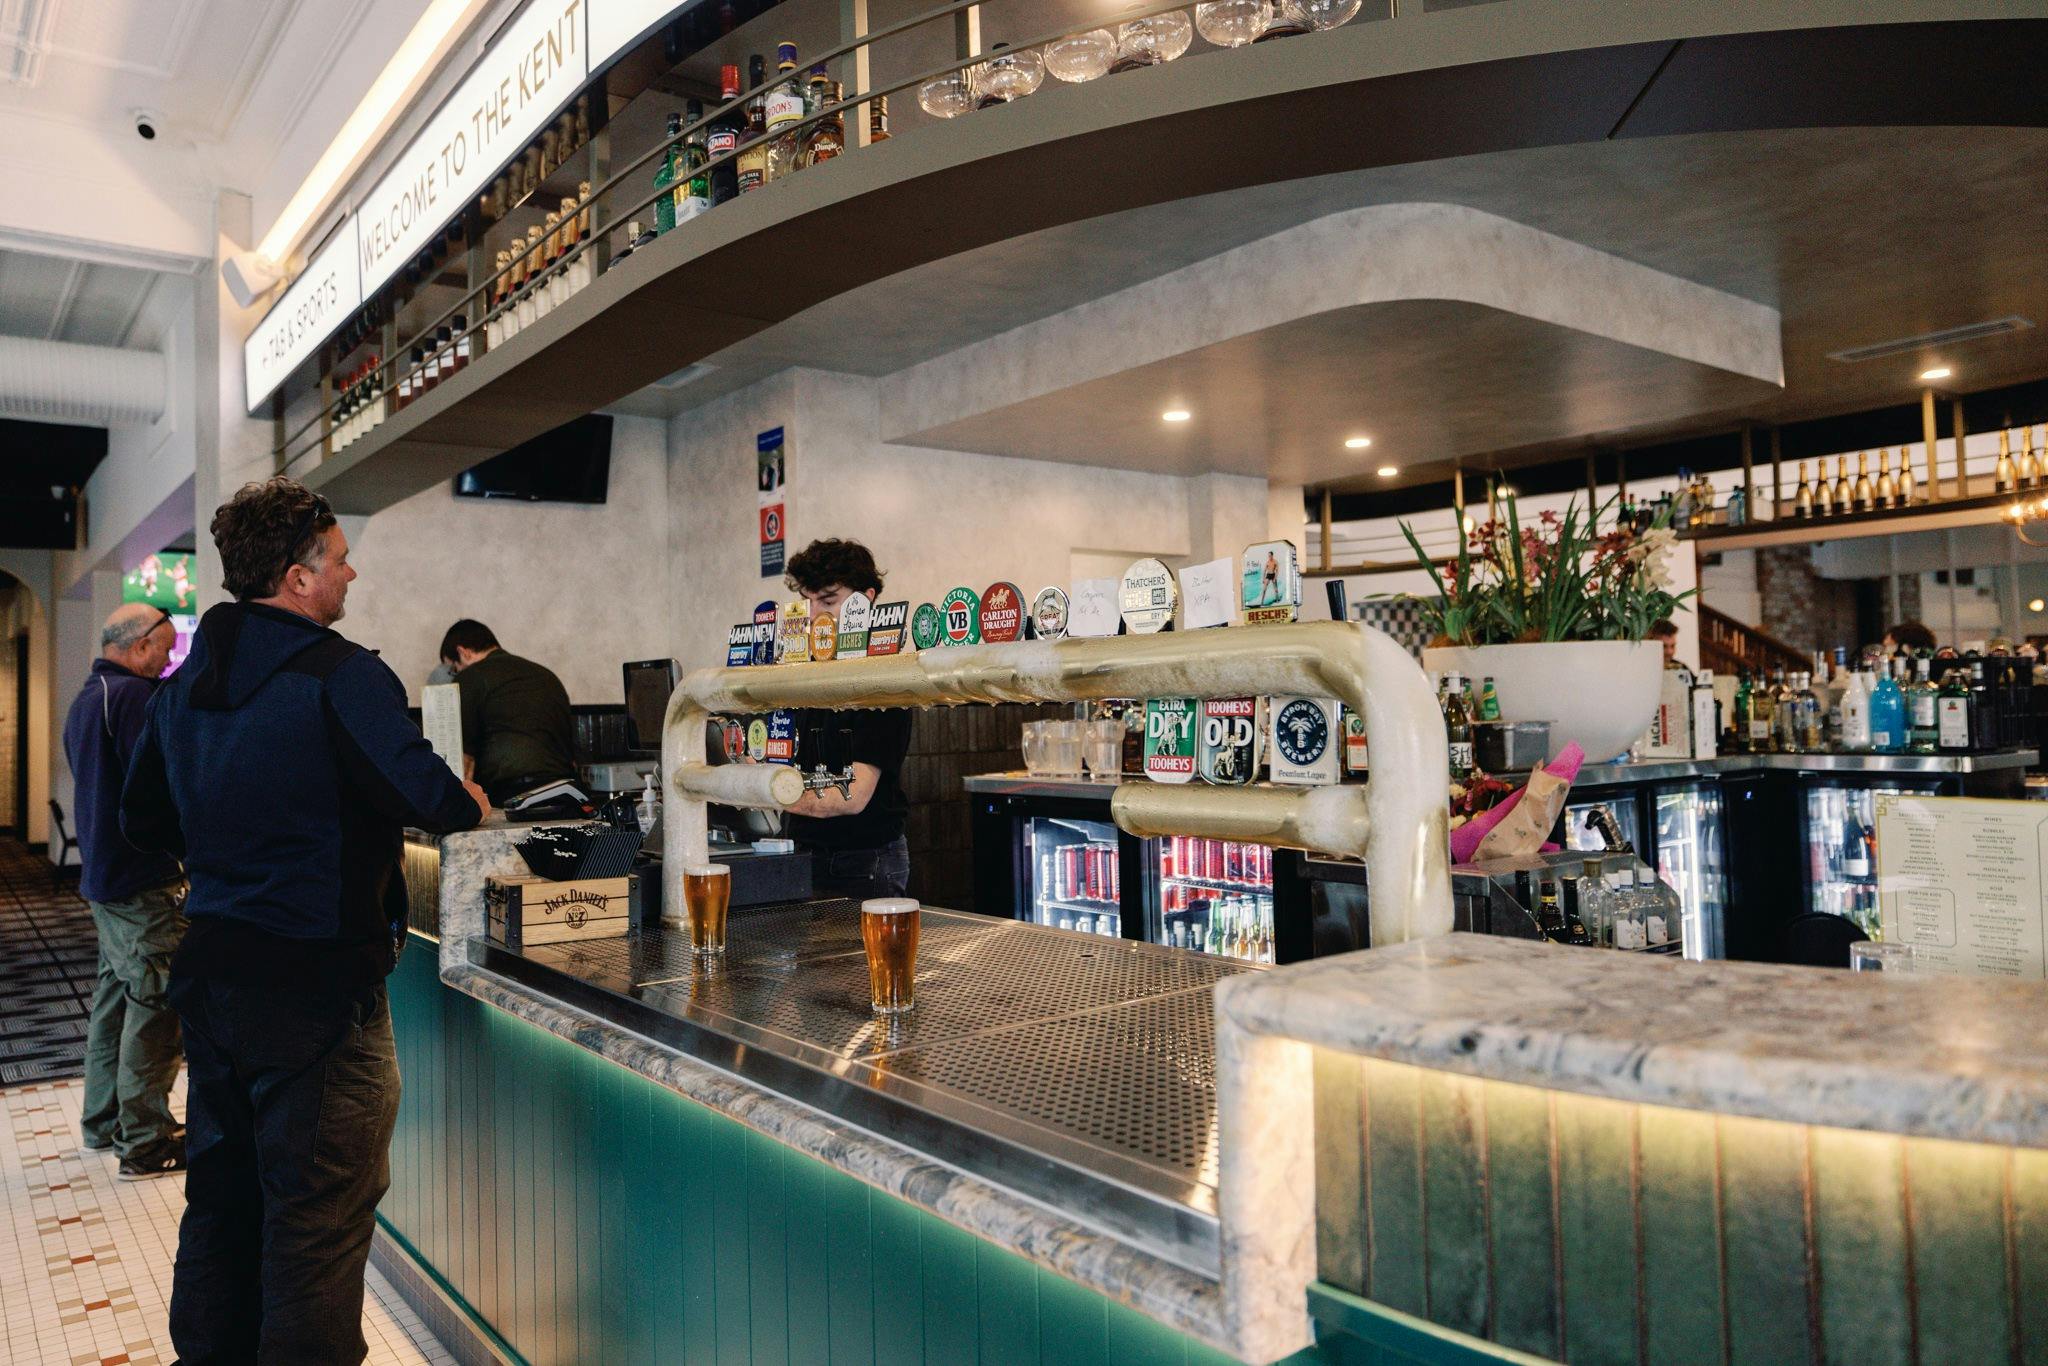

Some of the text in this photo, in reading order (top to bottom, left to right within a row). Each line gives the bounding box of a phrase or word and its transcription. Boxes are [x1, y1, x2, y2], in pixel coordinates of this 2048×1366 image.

[362, 0, 580, 273] WELCOME TO THE KENT
[711, 136, 732, 149] ZANO
[814, 143, 838, 153] Dimple
[297, 271, 337, 340] SPORTS
[1125, 574, 1166, 590] THATCHERS
[941, 589, 976, 613] VICTORIA
[869, 605, 906, 628] HAHN
[948, 611, 968, 630] VB
[981, 609, 1018, 622] CARLTON
[983, 619, 1017, 630] DRAUGHT
[727, 626, 754, 645] HAHN
[754, 623, 775, 643] NEW
[840, 633, 863, 649] LASHES
[1159, 700, 1186, 711] EXTRA
[1207, 701, 1251, 714] TOOHEYS
[1281, 703, 1325, 725] BYRON BAY
[1149, 711, 1194, 739] DRY
[1204, 718, 1253, 747] OLD
[767, 742, 788, 756] GINGER
[1281, 741, 1323, 762] BREWERY
[1149, 757, 1190, 771] TOOHEYS
[544, 893, 570, 915] JACK
